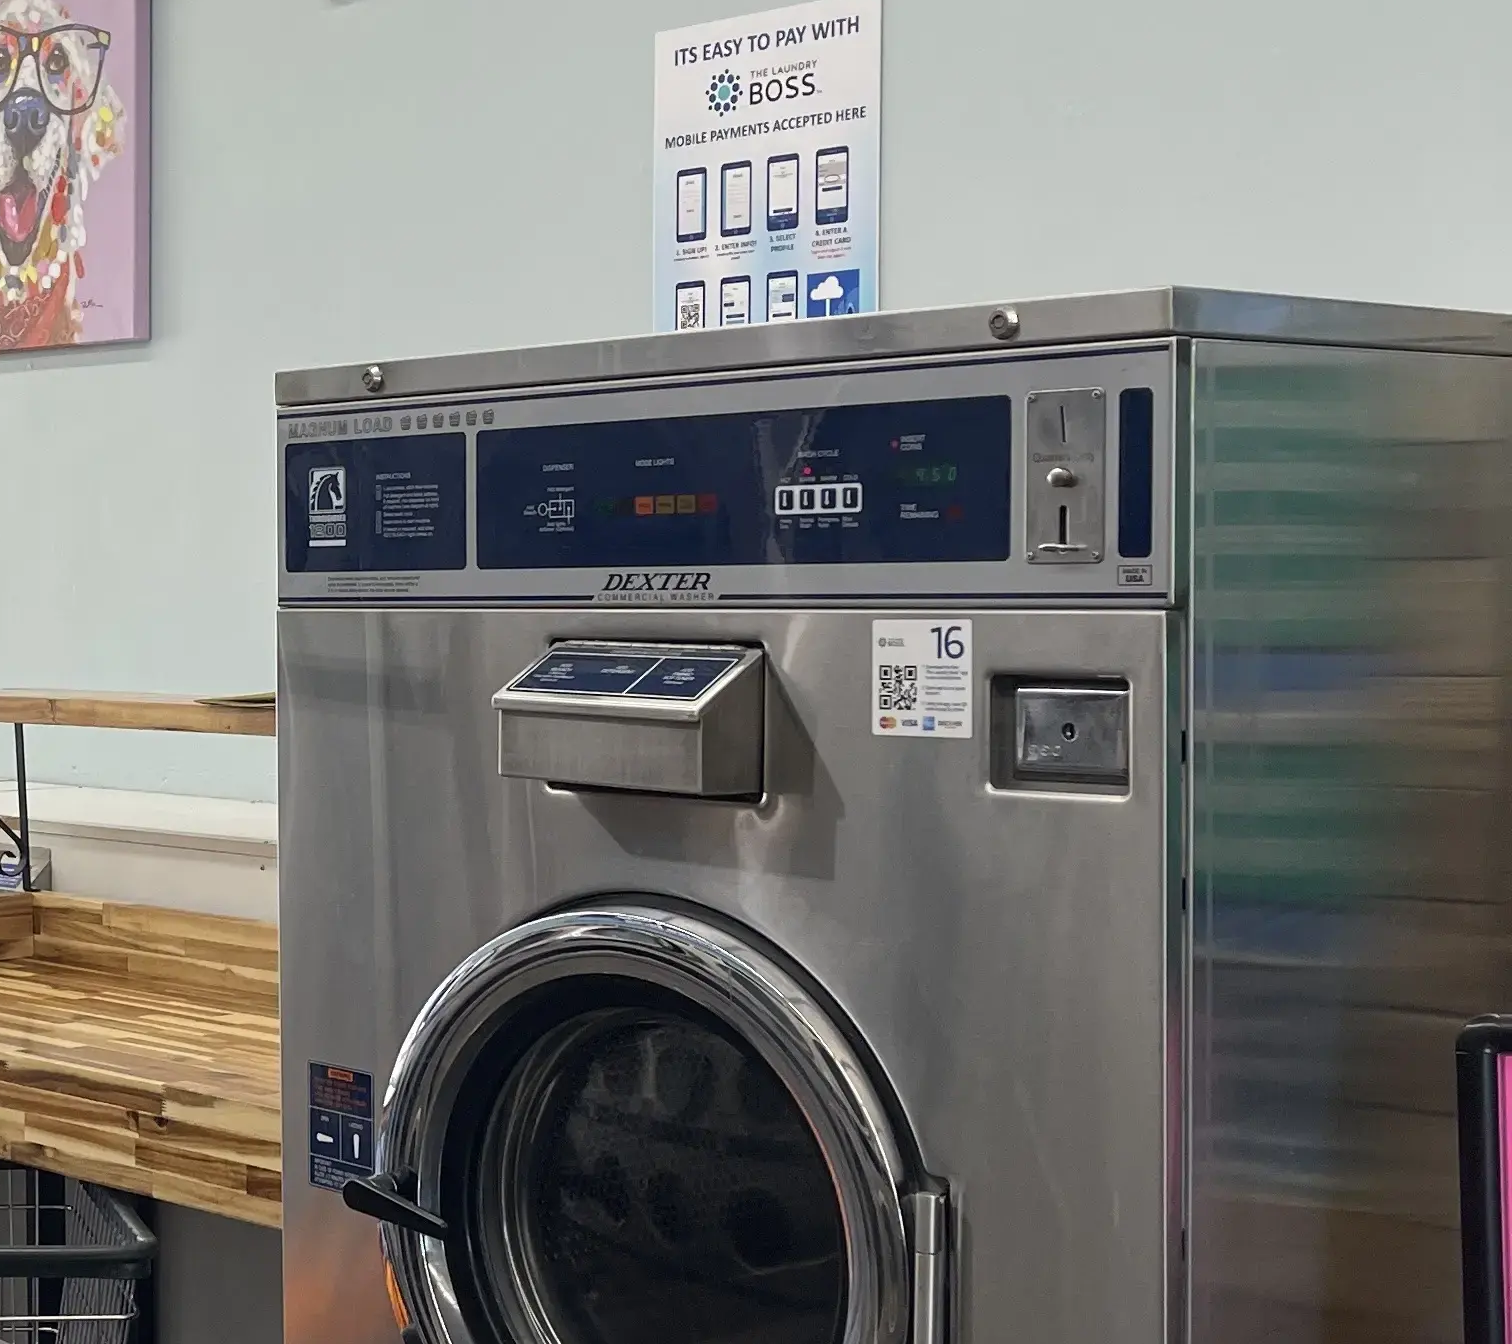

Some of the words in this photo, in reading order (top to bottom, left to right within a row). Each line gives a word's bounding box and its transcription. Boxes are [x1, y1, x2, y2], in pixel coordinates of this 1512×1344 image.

[674, 46, 698, 67] ITS
[702, 37, 743, 62] EASY
[747, 32, 771, 53] TO
[775, 25, 807, 48] PAY
[811, 15, 861, 41] WITH
[750, 68, 768, 79] THE
[771, 59, 818, 76] LAUNDRY
[748, 72, 816, 106] BOSS
[664, 131, 708, 150] MOBILE
[710, 121, 770, 143] PAYMENTS
[772, 111, 833, 132] ACCEPTED
[835, 105, 867, 123] HERE
[287, 420, 348, 439] MAGNUM
[353, 416, 393, 434] LOAD
[309, 523, 347, 539] 1200
[601, 572, 711, 592] DEXTER
[597, 593, 665, 602] COMMERCIAL
[670, 592, 715, 602] WASHER
[930, 625, 965, 660] 16
